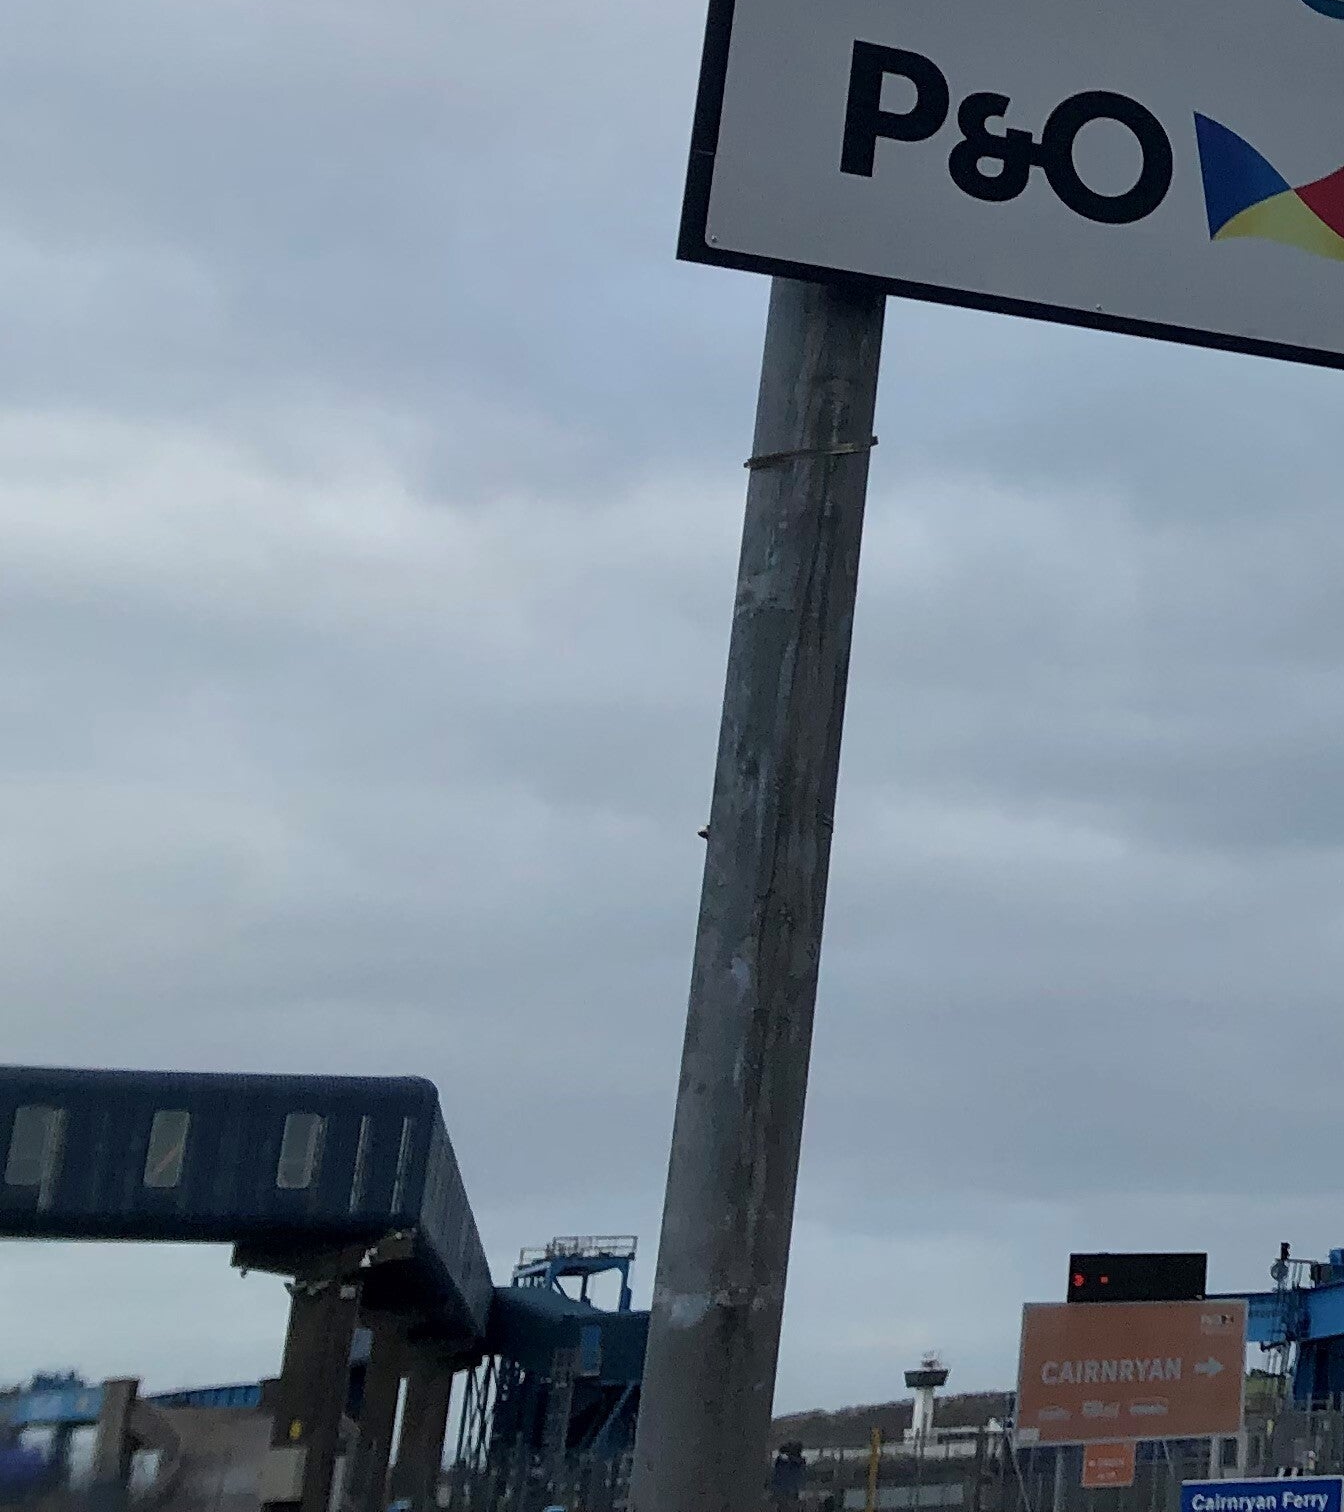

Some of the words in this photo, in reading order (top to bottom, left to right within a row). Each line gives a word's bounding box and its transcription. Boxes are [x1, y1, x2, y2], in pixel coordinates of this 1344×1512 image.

[840, 39, 1173, 224] P&O
[1041, 1358, 1181, 1385] CAIRNRYAN
[1191, 1492, 1277, 1512] Cairnryan
[1282, 1490, 1327, 1512] Ferry
